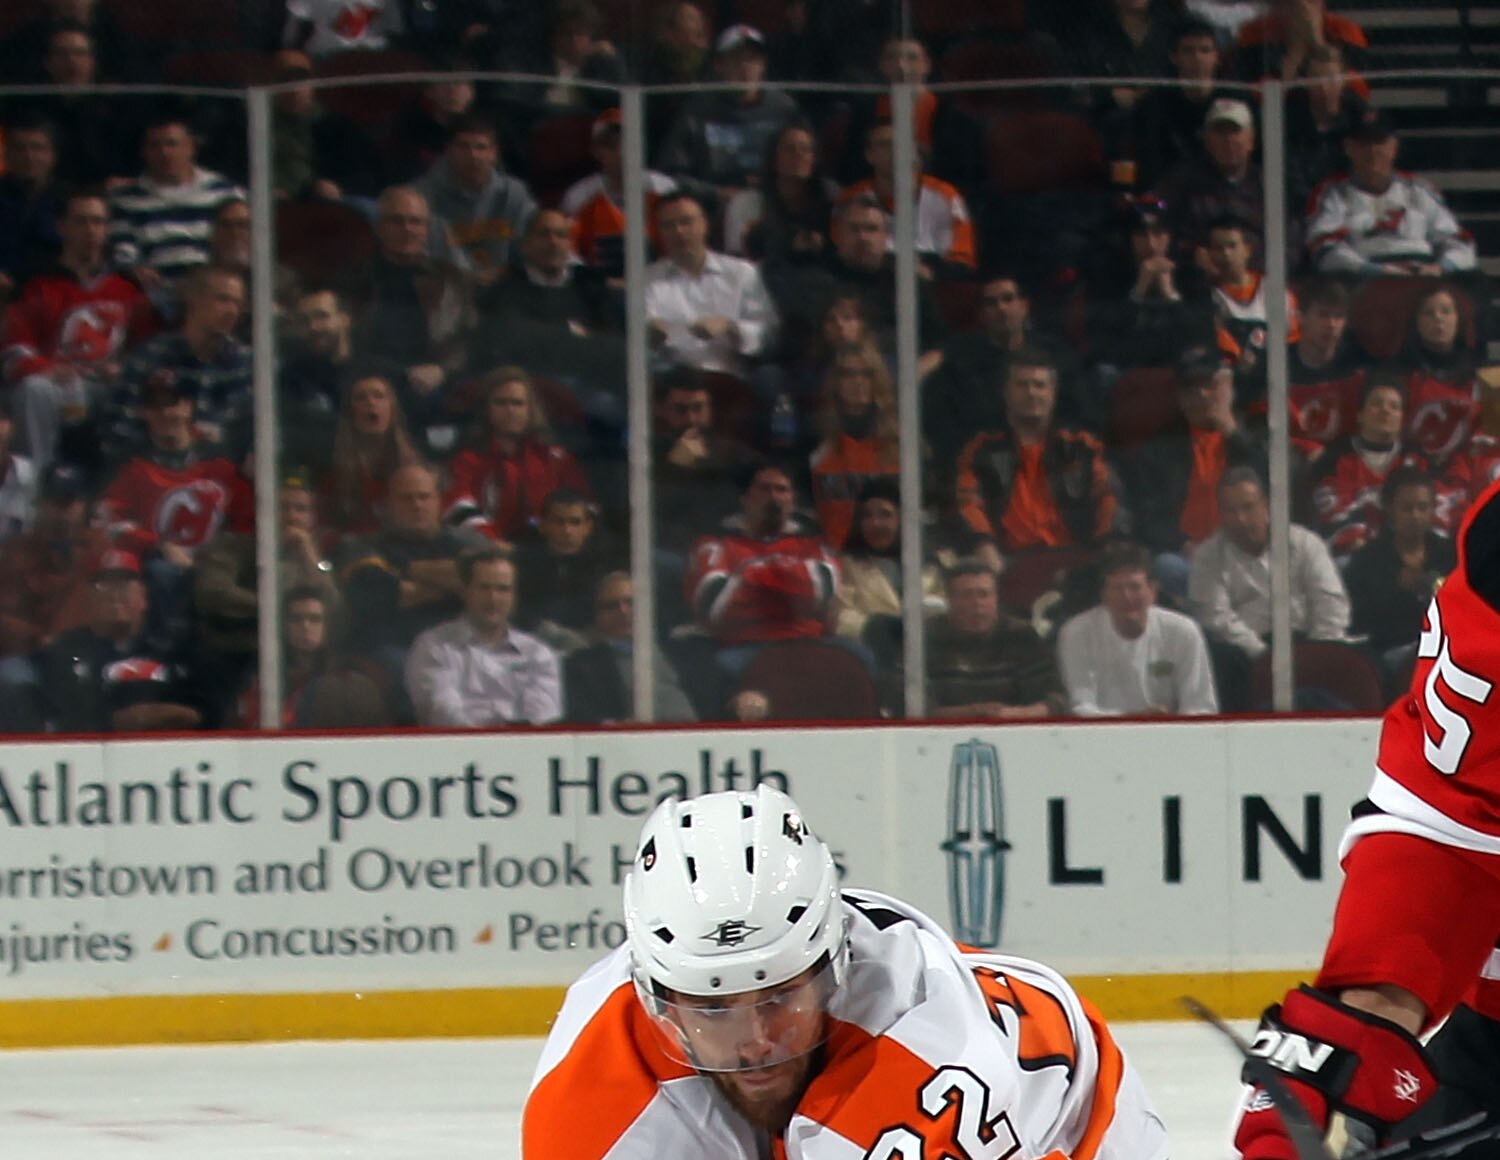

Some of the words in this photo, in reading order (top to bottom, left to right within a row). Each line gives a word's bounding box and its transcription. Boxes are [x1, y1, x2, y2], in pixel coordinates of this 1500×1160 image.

[281, 760, 518, 843] Sports
[548, 748, 791, 817] Health
[0, 853, 217, 898] rristown
[234, 846, 328, 894] and
[347, 842, 592, 893] Overlook
[1047, 794, 1324, 885] LIN
[185, 914, 456, 960] Concussion
